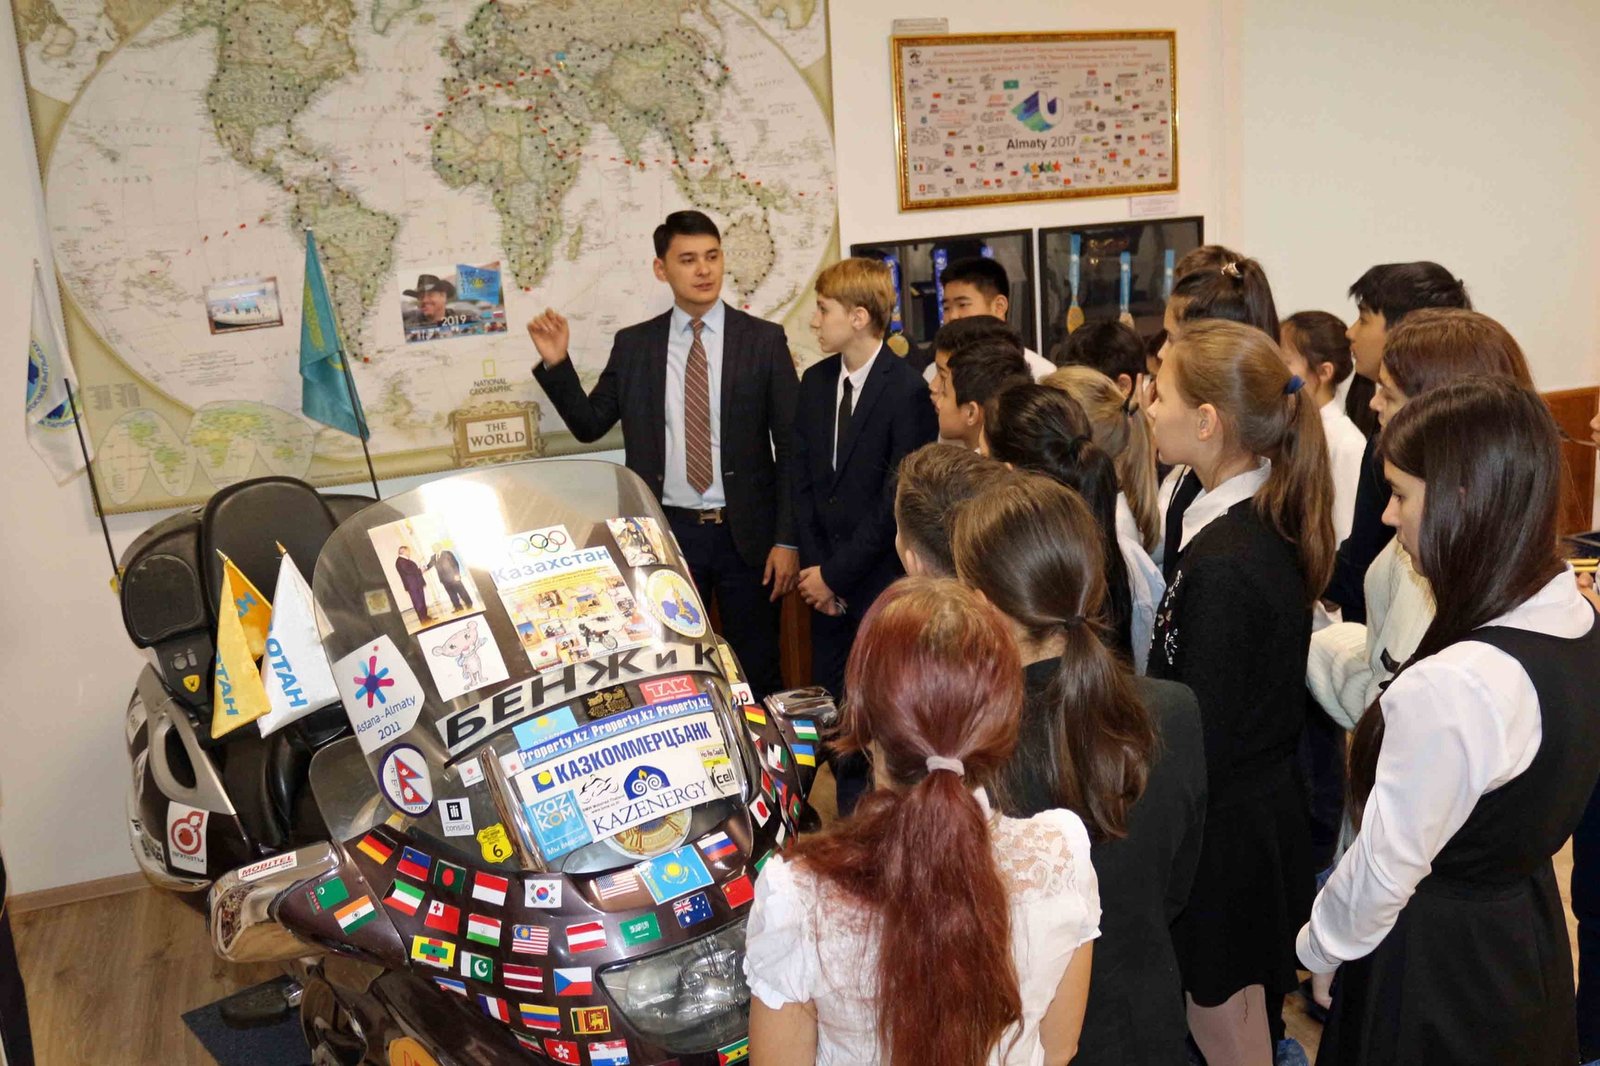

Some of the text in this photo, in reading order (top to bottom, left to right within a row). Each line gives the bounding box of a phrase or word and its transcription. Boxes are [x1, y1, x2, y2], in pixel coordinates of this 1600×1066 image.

[1006, 135, 1077, 151] Almaty 2017
[442, 314, 467, 327] 2019
[469, 384, 513, 396] GEOGRAPHIC
[473, 378, 507, 388] NATIONAL
[485, 421, 507, 433] THE
[470, 432, 525, 447] WORLD
[491, 550, 610, 583] Казахстан
[265, 637, 309, 708] ОТАН
[378, 720, 402, 741] 2011
[520, 731, 590, 763] Property.kz
[591, 709, 655, 736] Property.kz
[656, 696, 710, 717] Property.kz
[554, 721, 711, 785] КАЗКОММЕРЦБАНК
[593, 780, 709, 836] KAZENERGY
[492, 844, 503, 859] 6
[241, 854, 295, 876] MOBITEL
